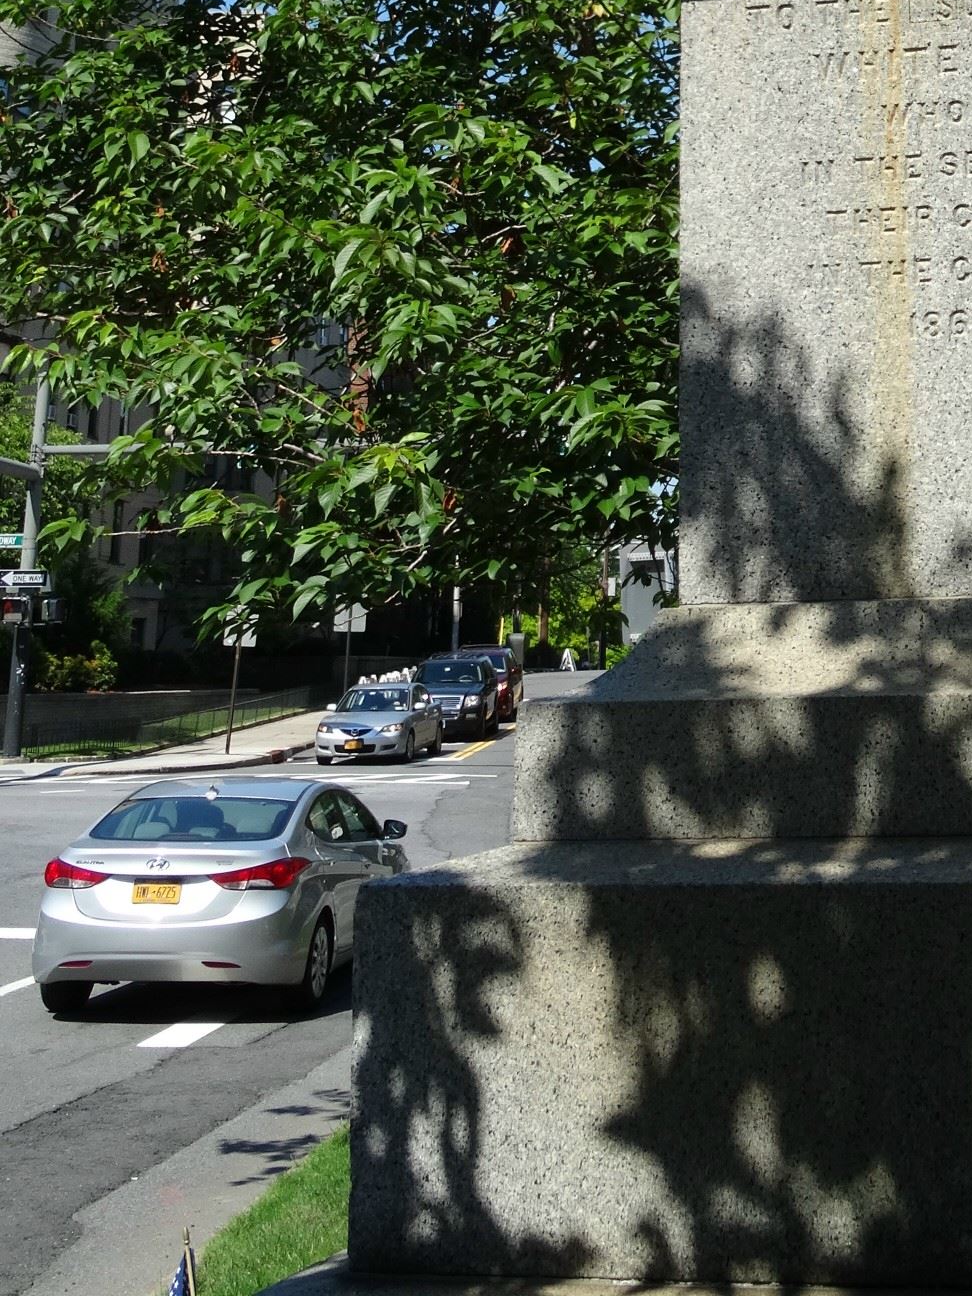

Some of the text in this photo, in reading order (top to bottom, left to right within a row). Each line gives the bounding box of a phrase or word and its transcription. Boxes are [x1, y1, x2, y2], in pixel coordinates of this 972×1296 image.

[745, 4, 794, 30] TO
[812, 42, 959, 81] WHITE
[881, 99, 963, 129] WHO
[801, 159, 836, 184] IN
[854, 152, 922, 181] THE
[825, 204, 931, 235] THEIR
[807, 261, 842, 288] IN
[857, 256, 932, 287] THE
